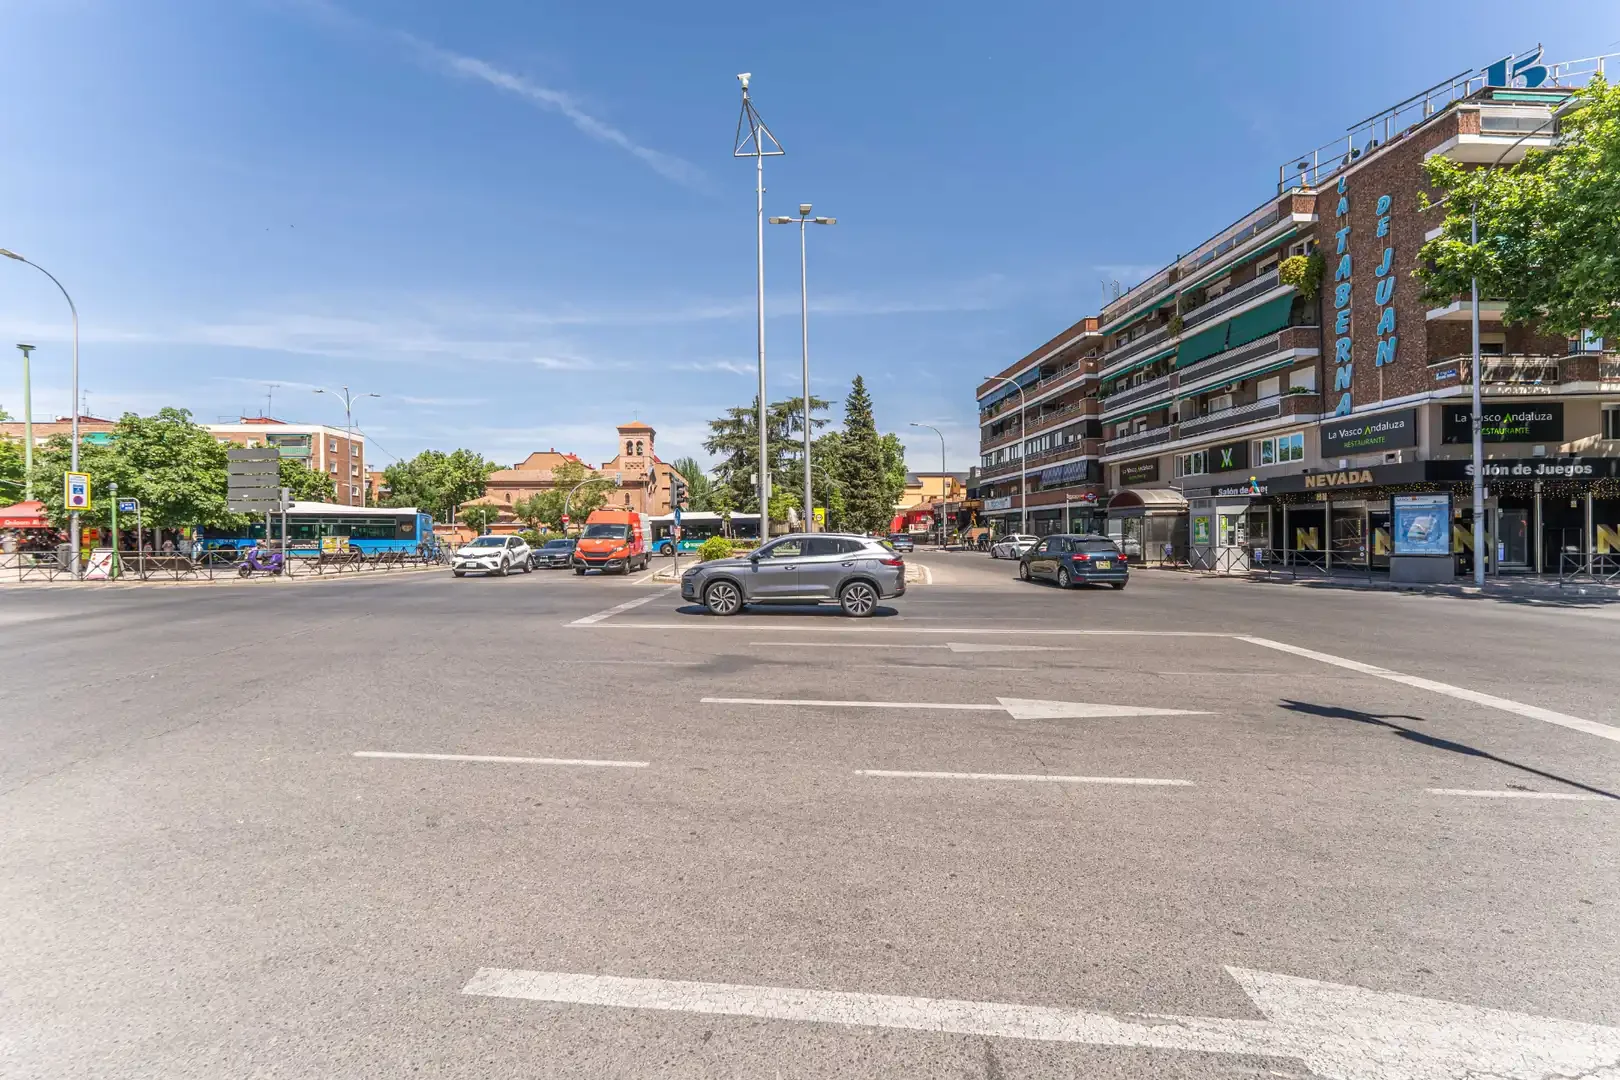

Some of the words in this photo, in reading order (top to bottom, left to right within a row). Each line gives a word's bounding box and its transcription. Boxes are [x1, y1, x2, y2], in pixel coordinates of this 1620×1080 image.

[1336, 175, 1349, 217] LA
[1375, 194, 1391, 238] DE
[1375, 247, 1397, 367] JUAN
[1335, 225, 1353, 417] TABERNA
[1455, 413, 1467, 423] La
[1504, 411, 1553, 423] Andaluza
[1328, 431, 1337, 440] La
[1339, 427, 1362, 438] Vasco
[1364, 420, 1405, 435] Andaluza
[1479, 427, 1530, 435] ESTAURANTE
[1343, 436, 1386, 448] RESTAURANTE
[1305, 470, 1373, 488] NEVADA
[1465, 463, 1509, 476] Slón
[1511, 464, 1532, 475] de
[1535, 463, 1593, 477] Juegos
[1218, 487, 1239, 496] Salón
[1239, 486, 1249, 494] de
